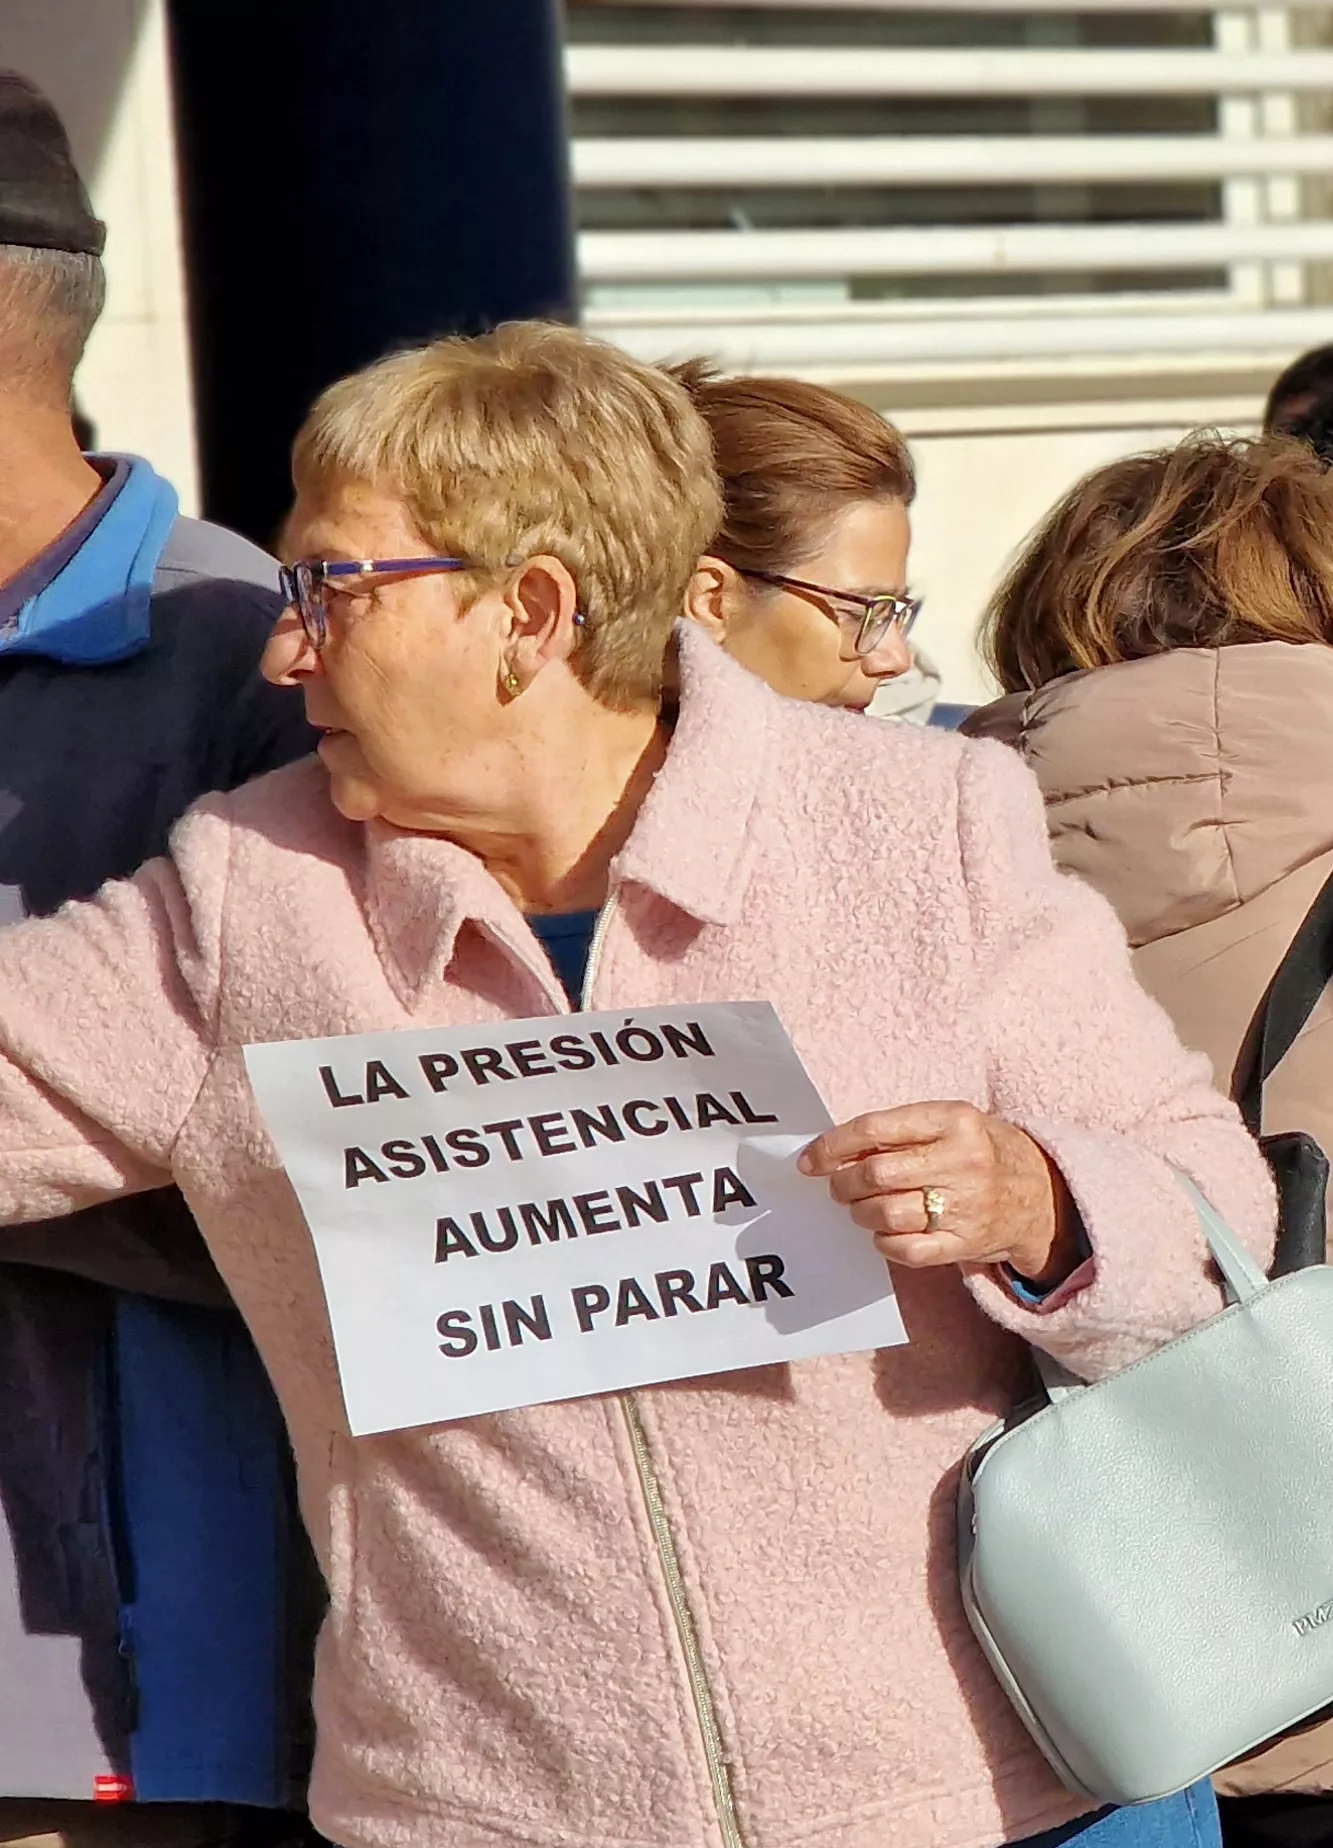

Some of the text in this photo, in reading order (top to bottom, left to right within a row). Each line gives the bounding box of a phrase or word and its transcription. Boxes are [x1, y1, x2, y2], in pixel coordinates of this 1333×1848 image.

[318, 1018, 717, 1108] LA PRESIÓN
[343, 1089, 780, 1190] ASISTENCIAL
[433, 1165, 758, 1264] AUMENTA
[435, 1253, 797, 1359] SIN PARAR
